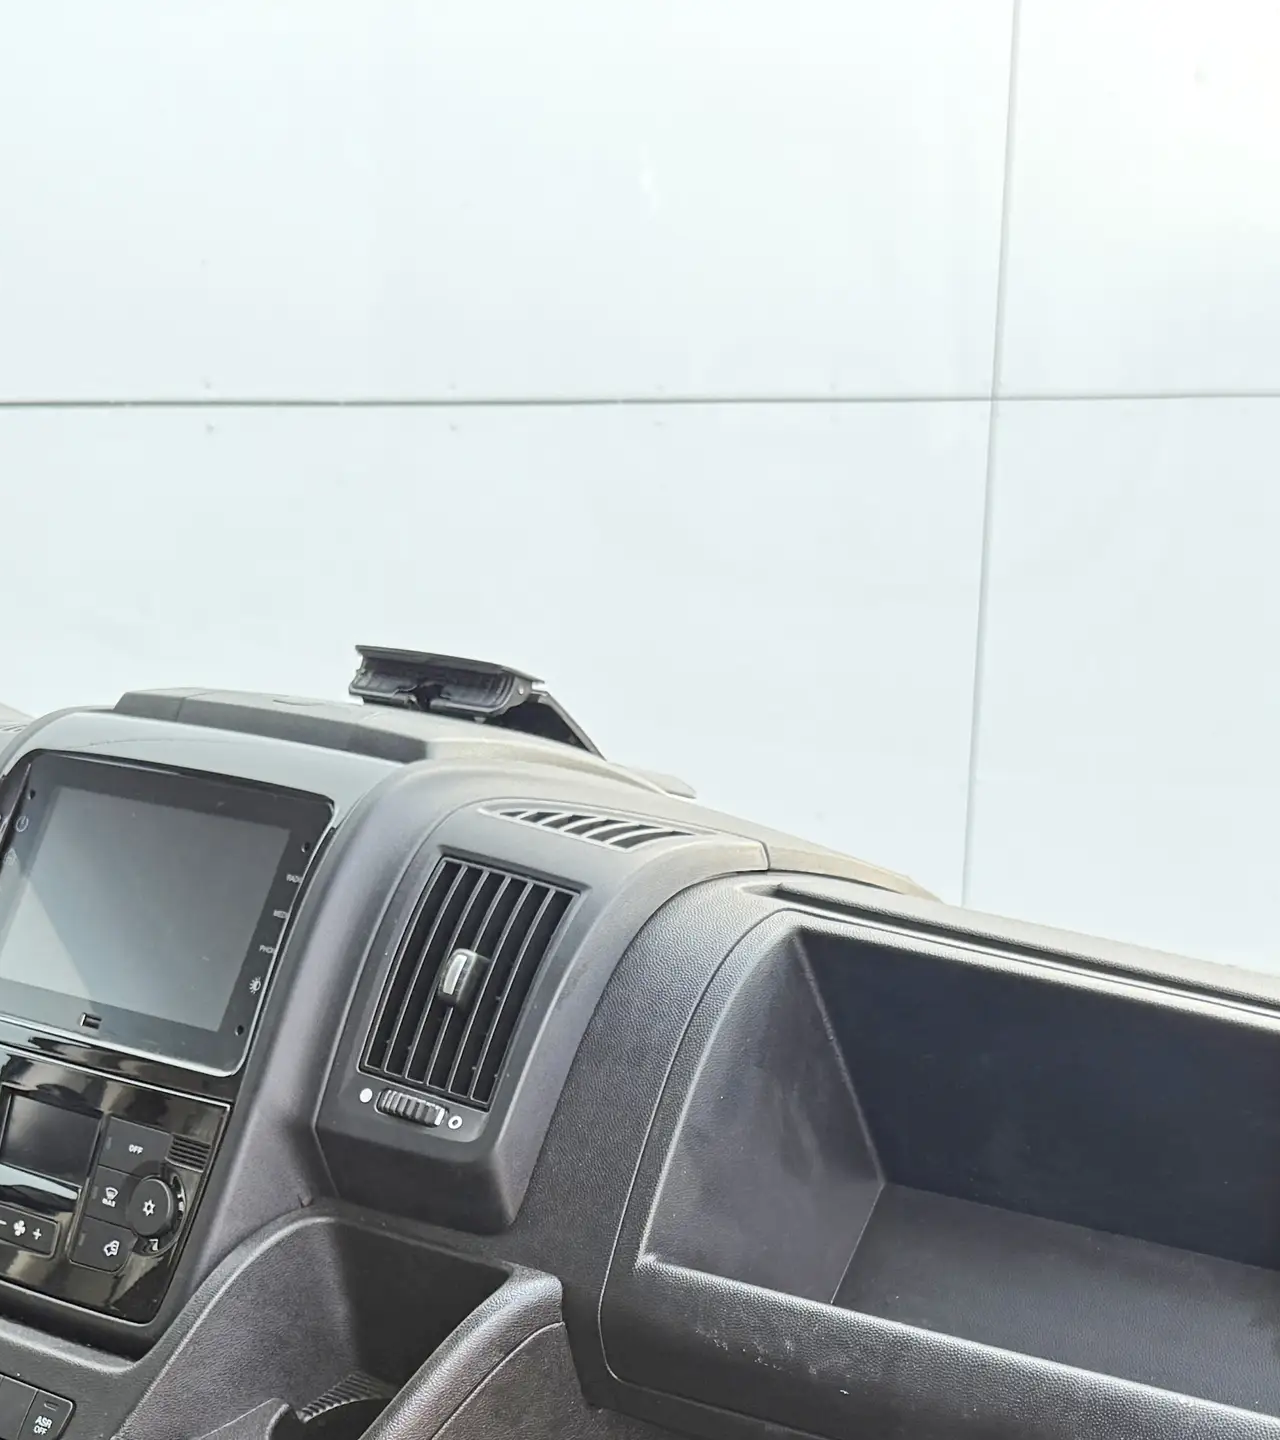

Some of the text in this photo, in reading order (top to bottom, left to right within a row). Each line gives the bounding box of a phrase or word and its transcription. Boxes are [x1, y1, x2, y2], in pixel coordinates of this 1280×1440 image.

[128, 1144, 144, 1155] OFF
[35, 1415, 53, 1429] ASR
[33, 1425, 48, 1436] OFF
